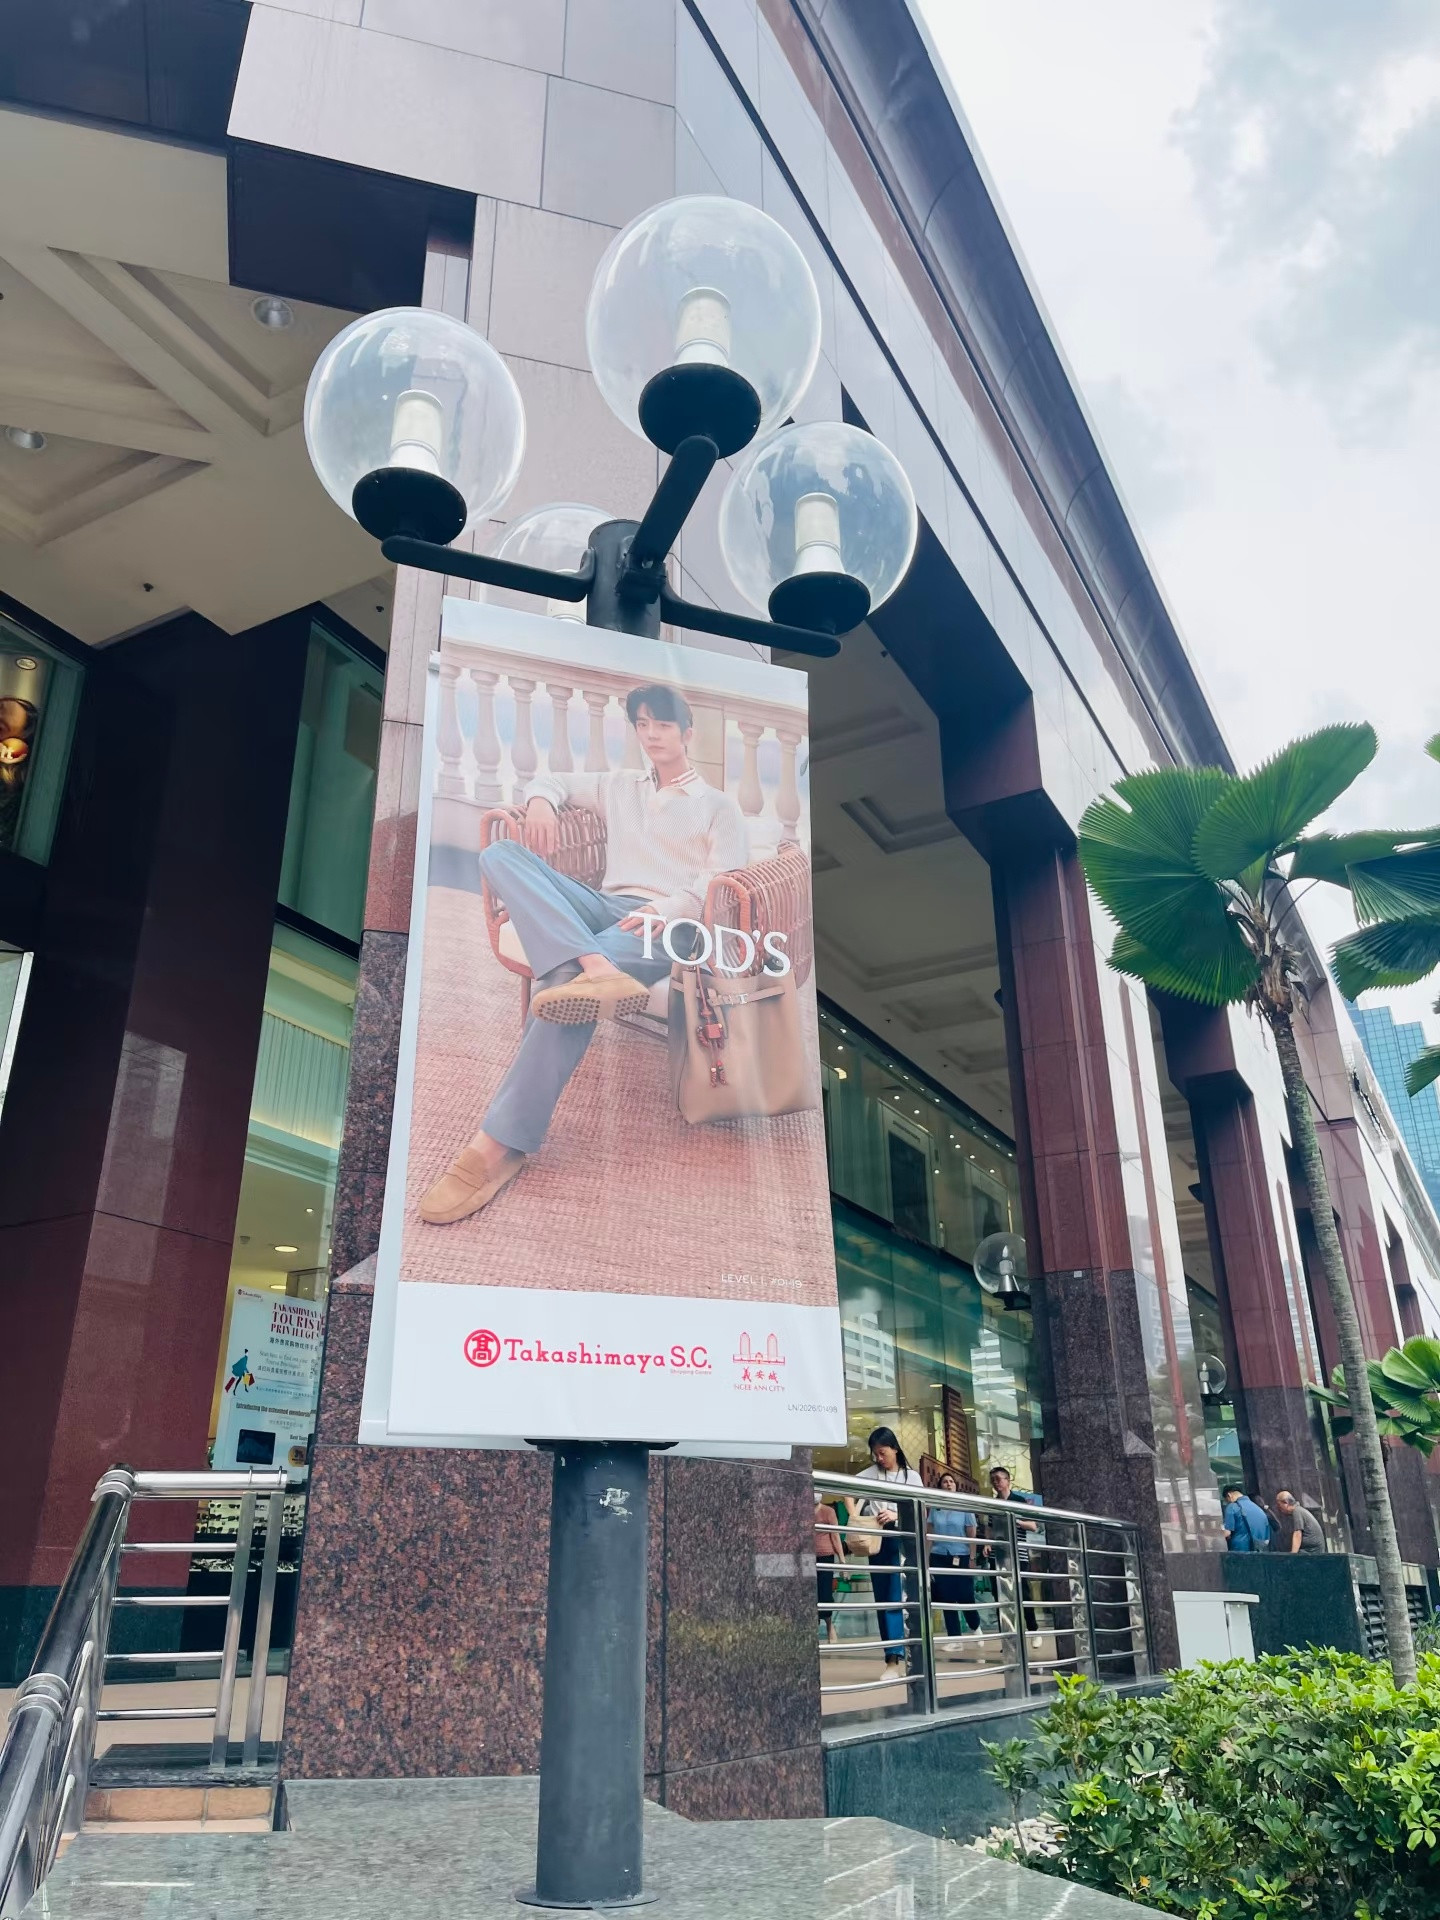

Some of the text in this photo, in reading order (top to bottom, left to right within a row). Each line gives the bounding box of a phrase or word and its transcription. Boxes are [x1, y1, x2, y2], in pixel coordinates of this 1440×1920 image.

[629, 911, 791, 977] TOD'S
[721, 1273, 756, 1285] LEVEL
[504, 1338, 666, 1374] Takashimaya
[670, 1345, 712, 1369] S.C.
